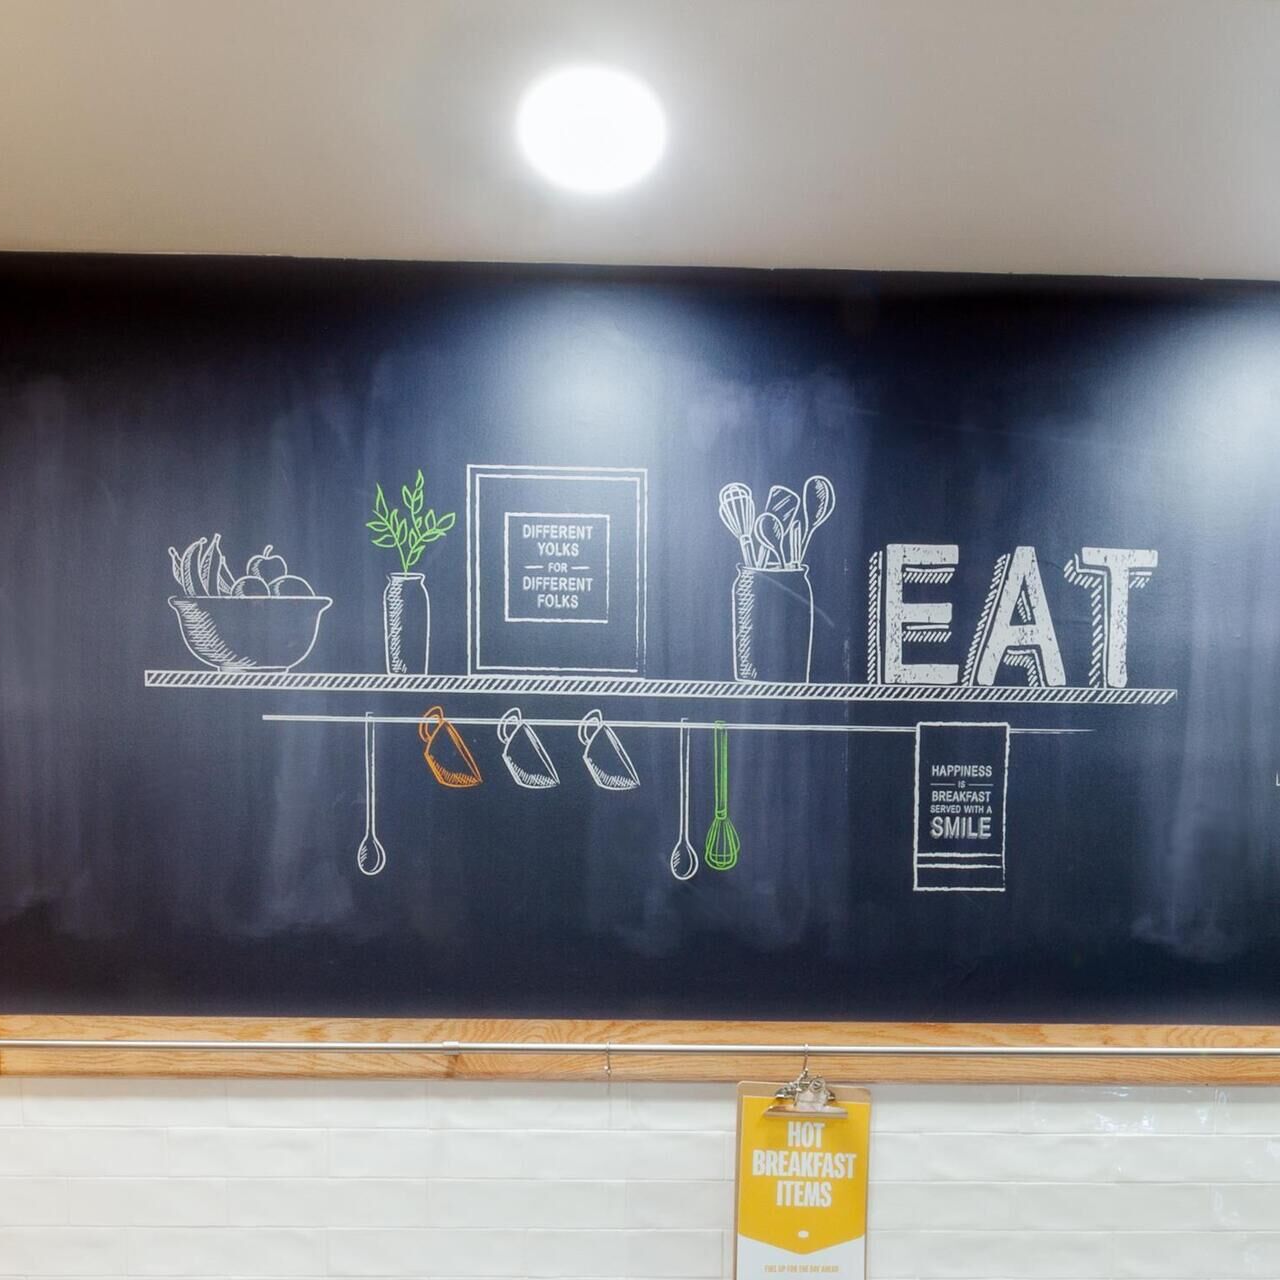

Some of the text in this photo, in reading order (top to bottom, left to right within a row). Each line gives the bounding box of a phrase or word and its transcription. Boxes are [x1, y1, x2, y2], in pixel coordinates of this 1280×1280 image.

[522, 524, 593, 540] DIFFERENT
[537, 542, 579, 557] YOLKS
[548, 562, 568, 573] FOR
[522, 576, 593, 592] DIFFERENT
[537, 593, 579, 609] FOLKS
[868, 543, 1158, 689] EAT
[931, 764, 992, 777] HAPPINESS
[958, 780, 966, 788] IS
[932, 790, 991, 802] BREAKFAST
[930, 805, 992, 814] SERVED WITH A
[930, 816, 992, 839] SMILE
[787, 1121, 825, 1148] HOT
[751, 1149, 857, 1179] BREAKFAST
[775, 1180, 832, 1208] ITEMS
